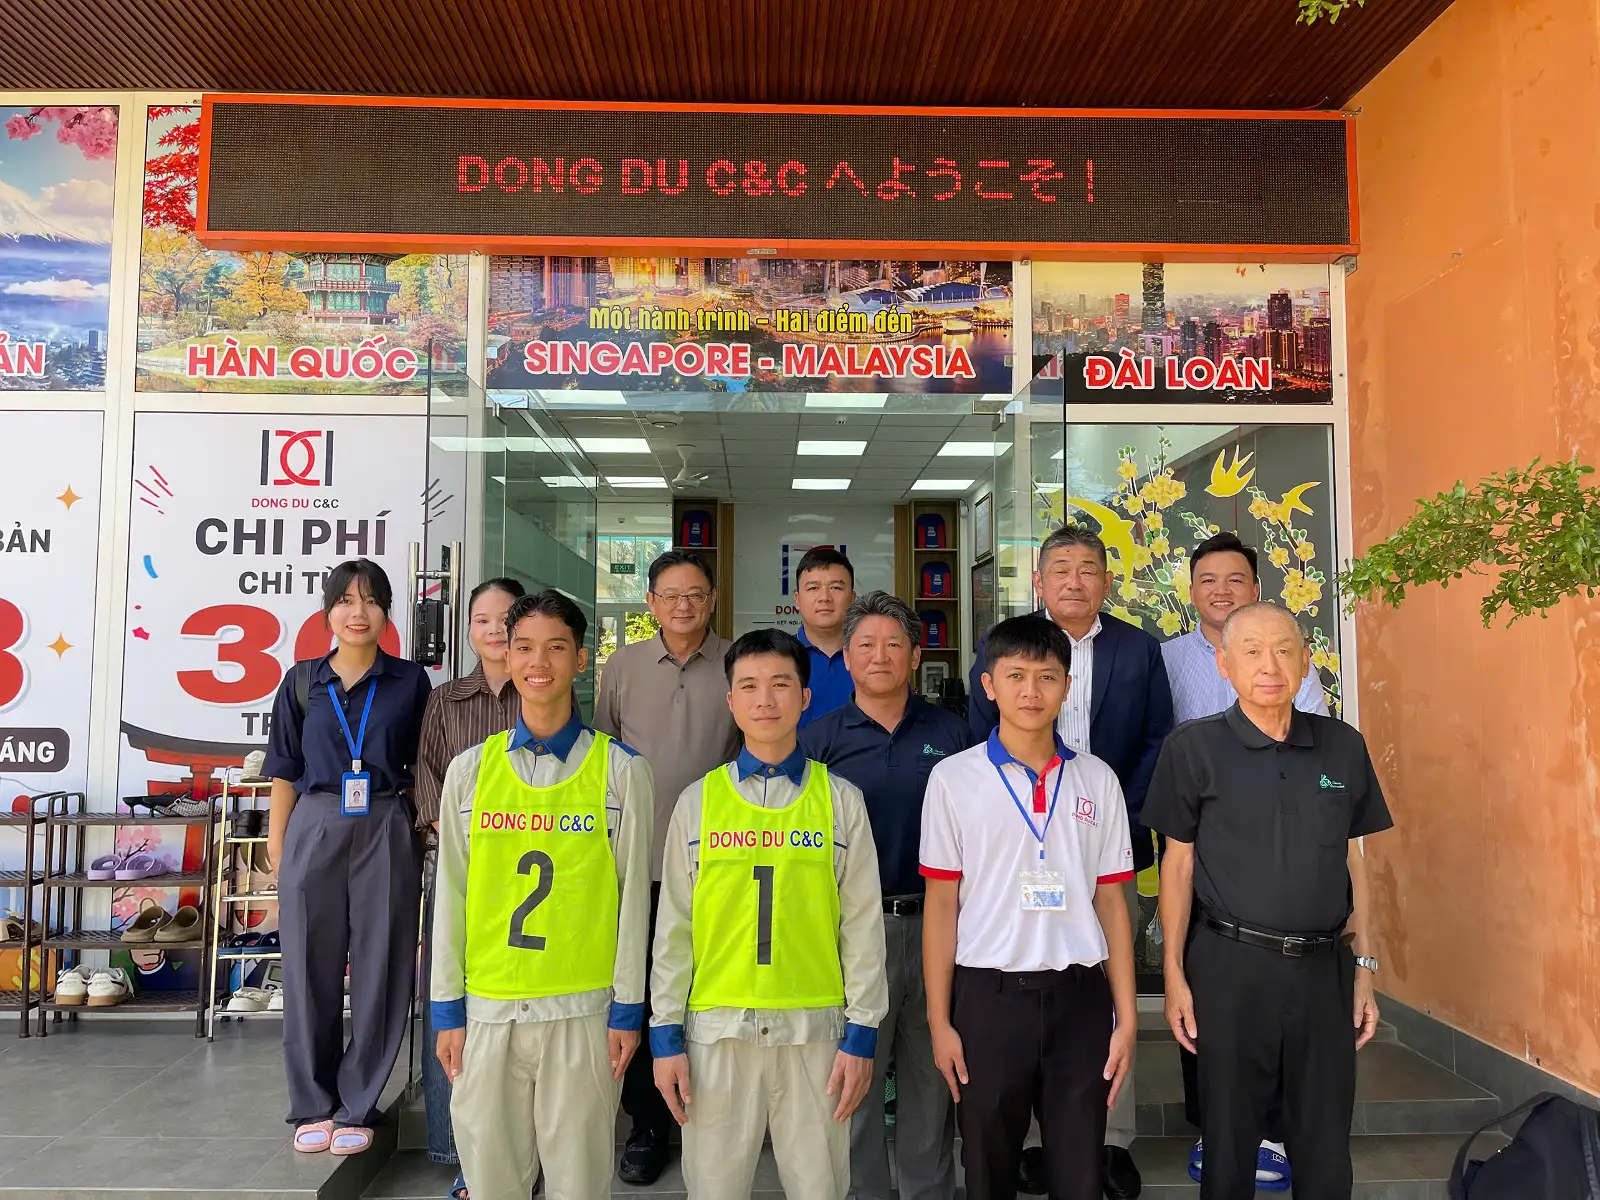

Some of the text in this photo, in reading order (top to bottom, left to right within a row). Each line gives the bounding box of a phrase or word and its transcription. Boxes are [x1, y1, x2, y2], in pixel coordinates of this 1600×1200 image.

[458, 156, 603, 193] DONG
[622, 158, 688, 195] DU
[706, 159, 807, 196] C&C
[589, 305, 631, 334] Một
[638, 306, 690, 331] hành
[697, 307, 750, 331] trình
[776, 309, 810, 333] Hai
[816, 303, 868, 333] điểm
[874, 305, 913, 333] đến
[187, 336, 277, 378] HÀN
[289, 335, 418, 380] QUỐC
[525, 342, 750, 375] SINGAPORE
[784, 345, 975, 377] MALAYSIA
[1085, 348, 1153, 388] ĐÀI
[1167, 357, 1272, 389] LOAN
[251, 498, 339, 509] DONG DU C&C
[195, 510, 392, 555] CHI PHÍ
[238, 564, 293, 595] CHỈ
[480, 811, 595, 832] DONG DU C&C
[709, 830, 824, 849] DONG DU C&C
[508, 850, 554, 951] 2
[753, 865, 775, 965] 1
